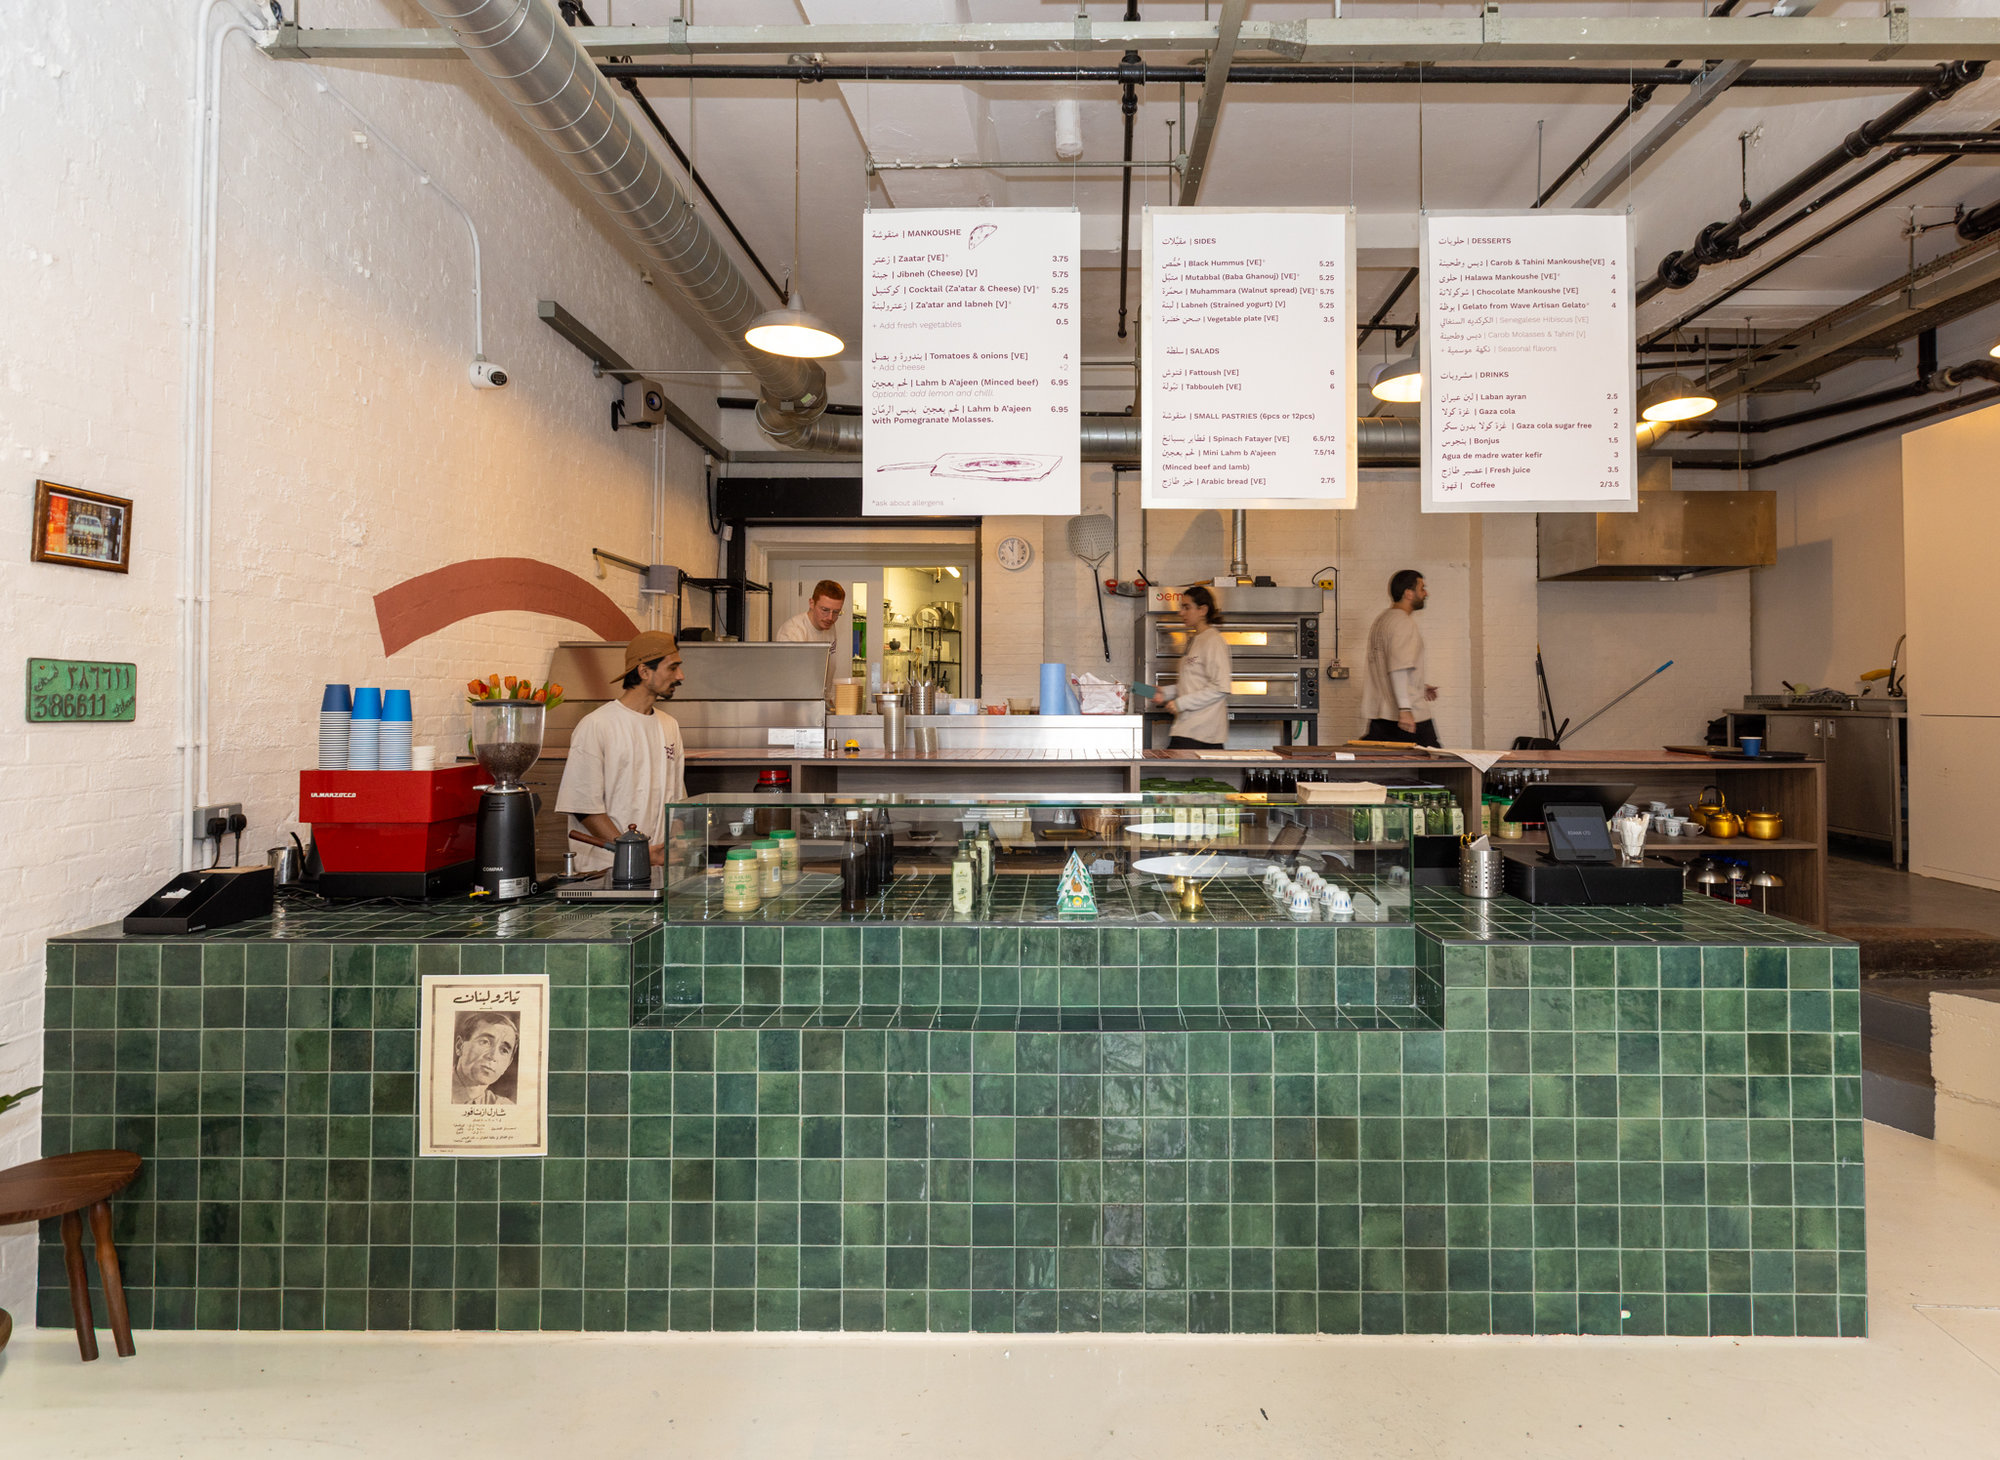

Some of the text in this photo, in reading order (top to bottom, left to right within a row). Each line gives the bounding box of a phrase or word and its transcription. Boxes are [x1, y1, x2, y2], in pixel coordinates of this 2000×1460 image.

[908, 229, 961, 237] MANKOUSHE
[897, 270, 925, 278] Jibneh
[927, 269, 963, 278] (Cheese)
[1222, 273, 1244, 281] (Baba
[909, 285, 1021, 293] Cocktail Cheese)
[1238, 287, 1268, 295] (Walnut
[947, 300, 993, 308] and labneh
[1210, 301, 1244, 309] (Strained
[1246, 301, 1273, 309] yogurt)
[1244, 315, 1262, 323] plate
[981, 378, 1014, 387] (Minced
[1017, 378, 1038, 387] beef)
[967, 405, 991, 413] Lahm
[1259, 412, 1280, 421] (6pcs
[1292, 413, 1315, 421] 12pcs)
[894, 417, 949, 425] Pomegranate
[1474, 437, 1500, 445] Bonjus
[1512, 466, 1531, 475] juice
[33, 692, 106, 718] 386611
